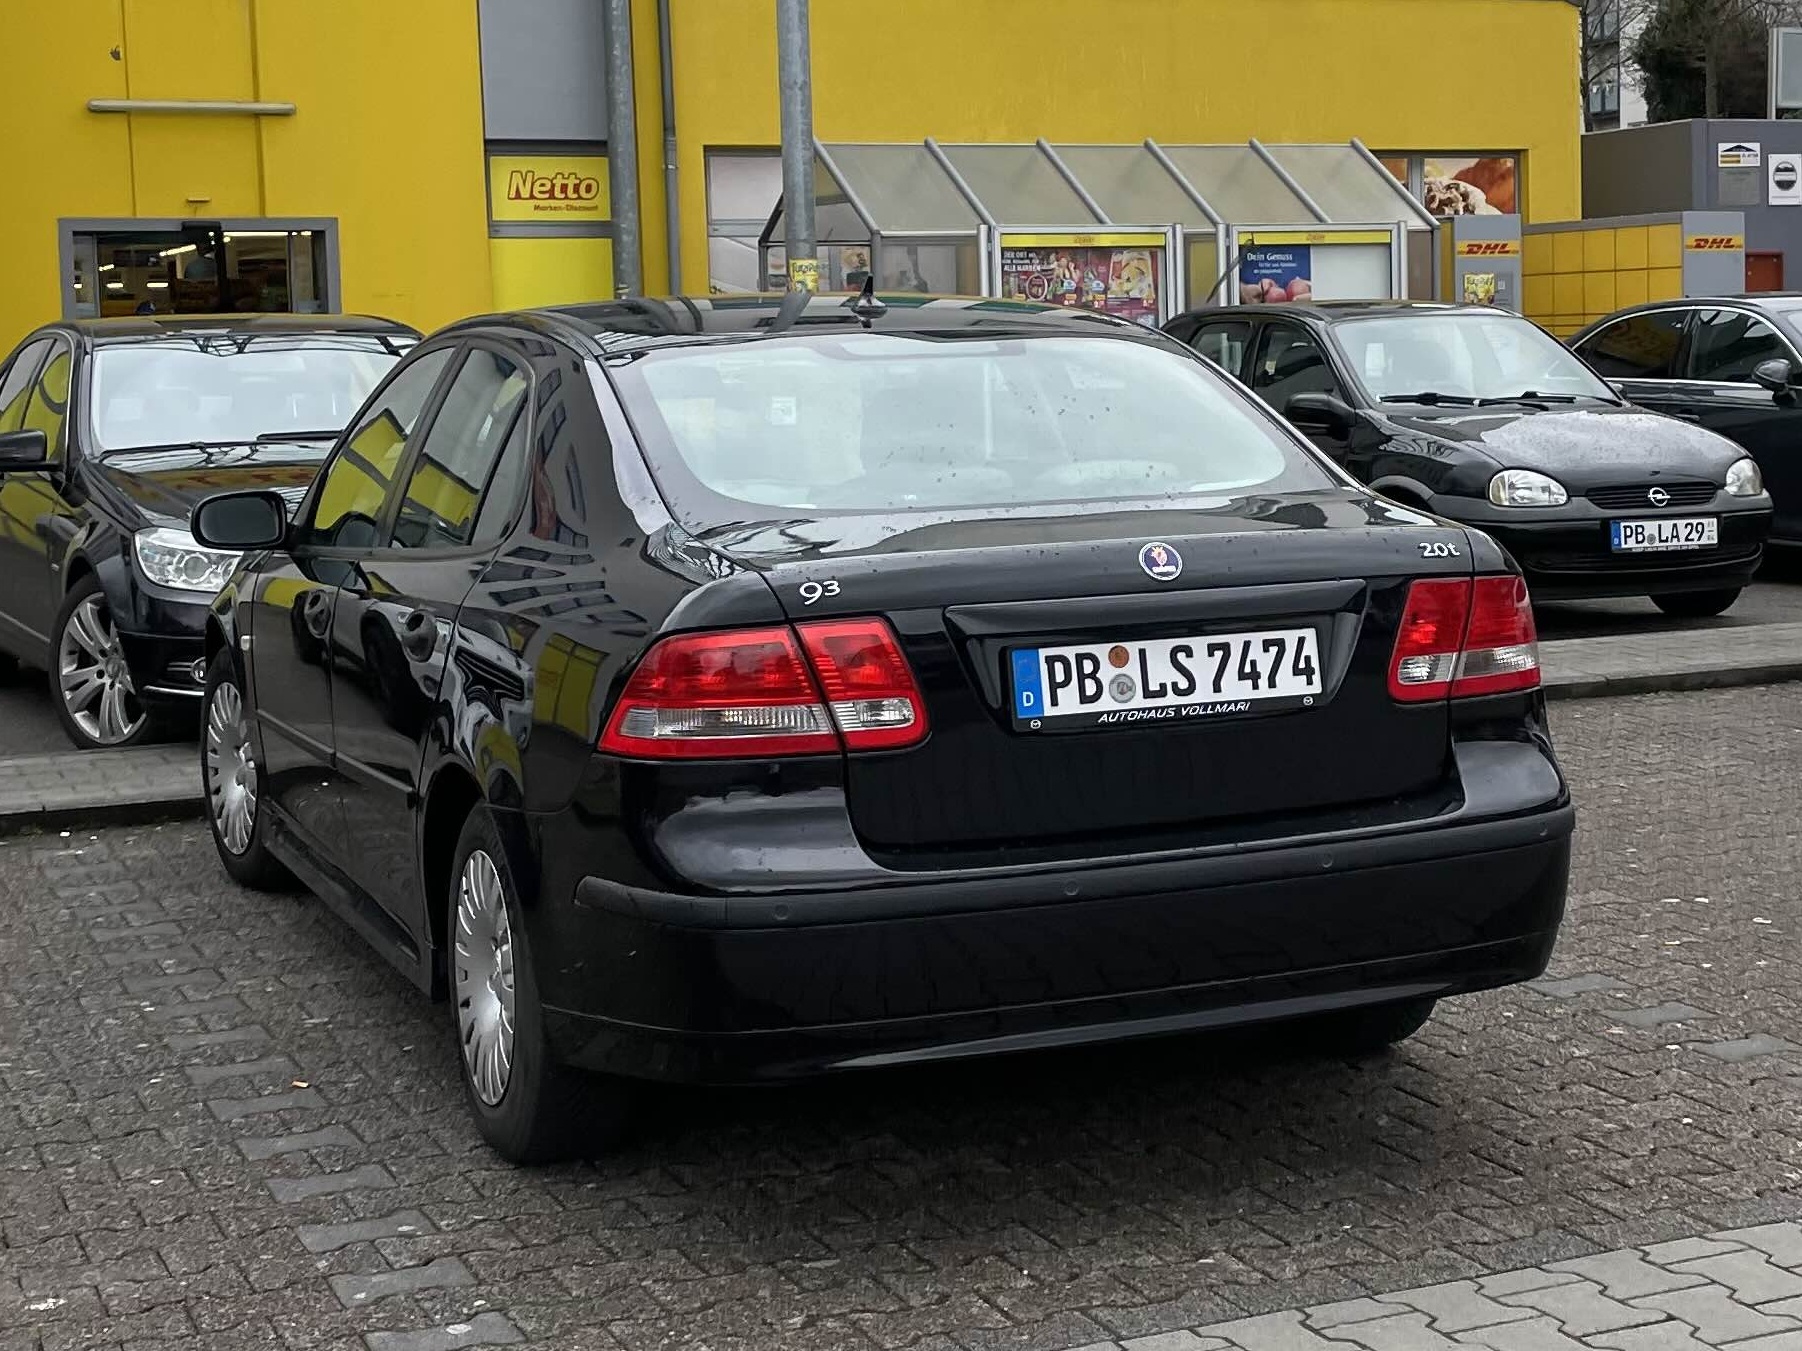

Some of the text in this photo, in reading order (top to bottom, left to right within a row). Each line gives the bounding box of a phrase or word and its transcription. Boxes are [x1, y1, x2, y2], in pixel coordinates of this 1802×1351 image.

[508, 170, 599, 200] Netto
[1466, 243, 1511, 255] DHL
[1693, 238, 1735, 249] DHL
[1622, 521, 1706, 545] PB LA 29
[1044, 636, 1317, 707] PB LS 7474
[1023, 691, 1034, 707] D
[1098, 701, 1251, 724] AUTOHAUS VOLLMARI
